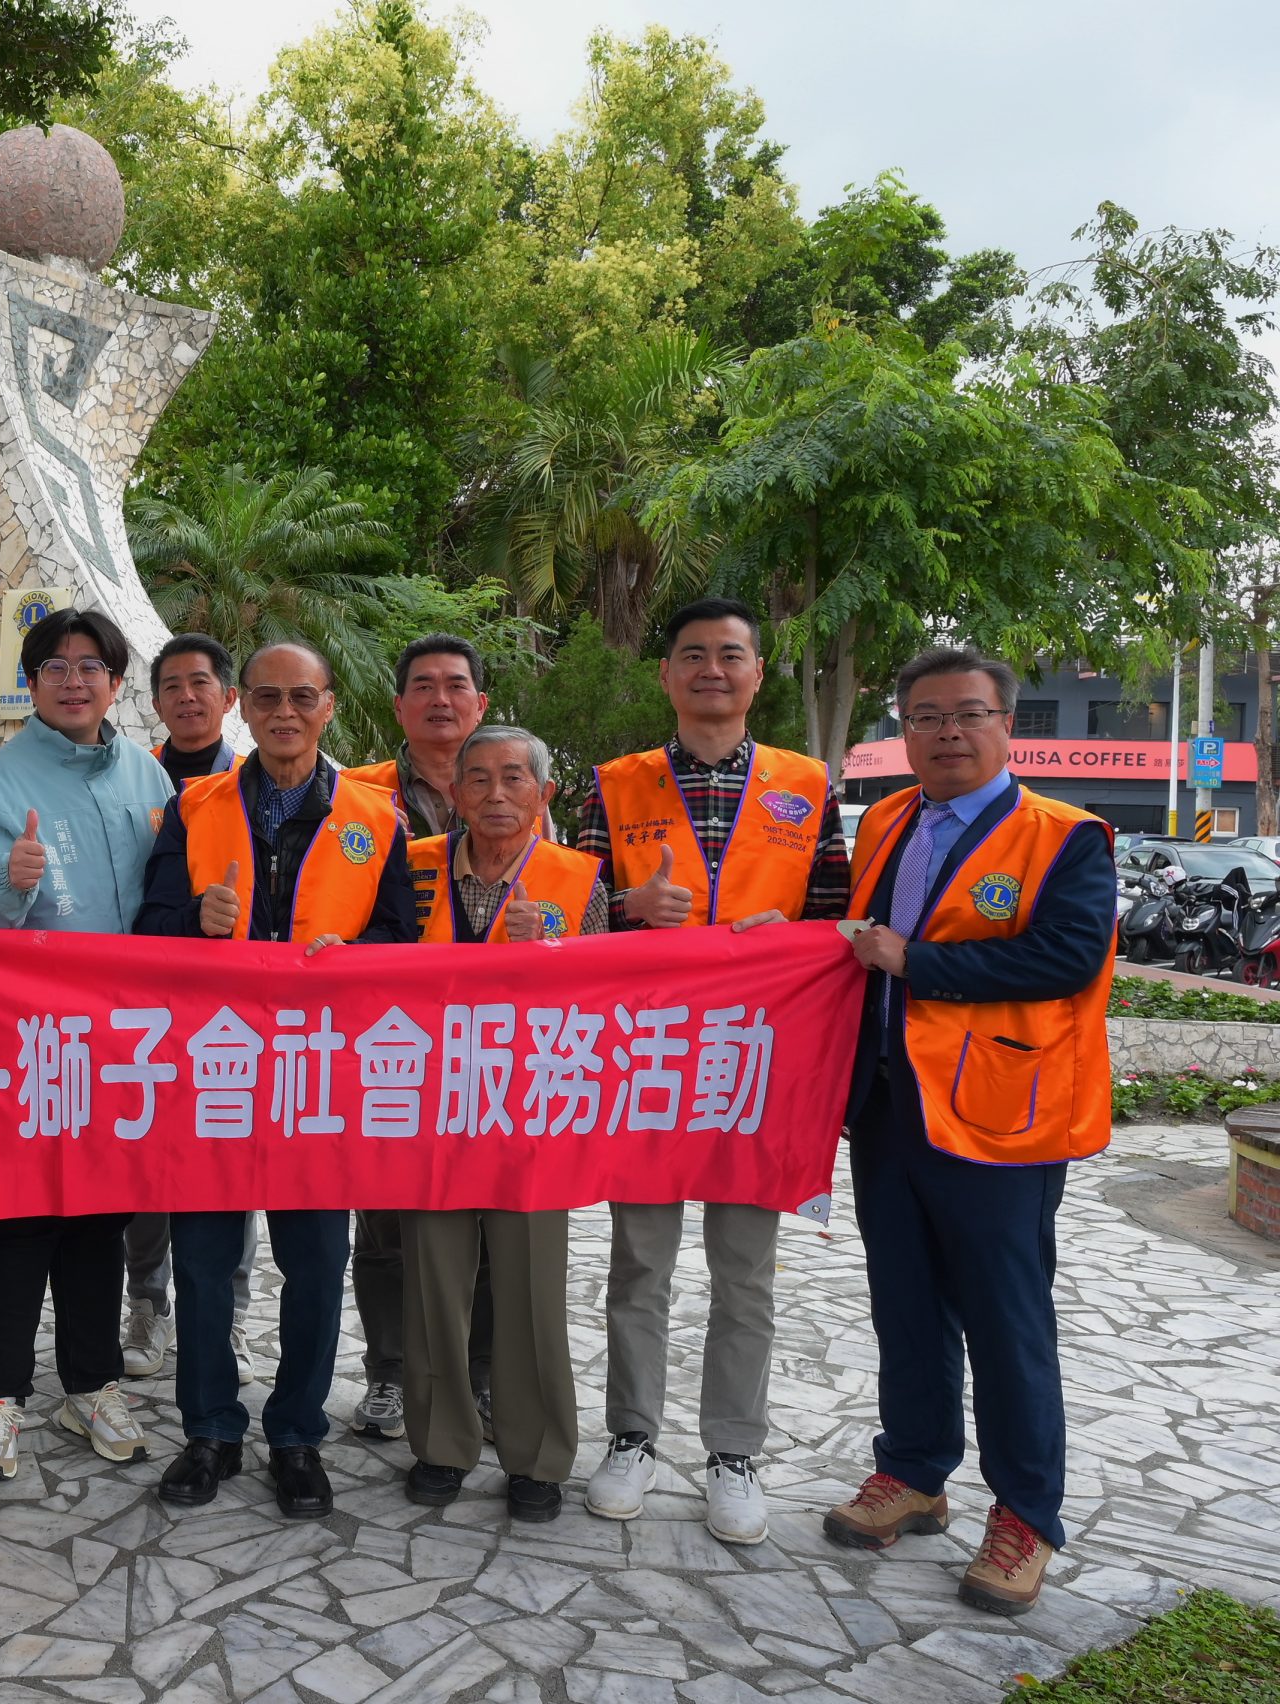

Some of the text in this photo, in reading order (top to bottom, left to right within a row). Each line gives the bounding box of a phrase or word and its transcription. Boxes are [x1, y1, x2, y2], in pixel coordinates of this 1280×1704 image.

[23, 592, 49, 604] LIONS
[1203, 742, 1217, 754] P
[852, 752, 873, 768] COFFEE
[1069, 751, 1147, 767] COFFEE
[348, 823, 371, 838] LIONS
[351, 834, 363, 851] L
[767, 835, 807, 853] 2023-2024
[986, 875, 1019, 890] LIONS
[990, 887, 1006, 906] L
[537, 901, 563, 915] IONS
